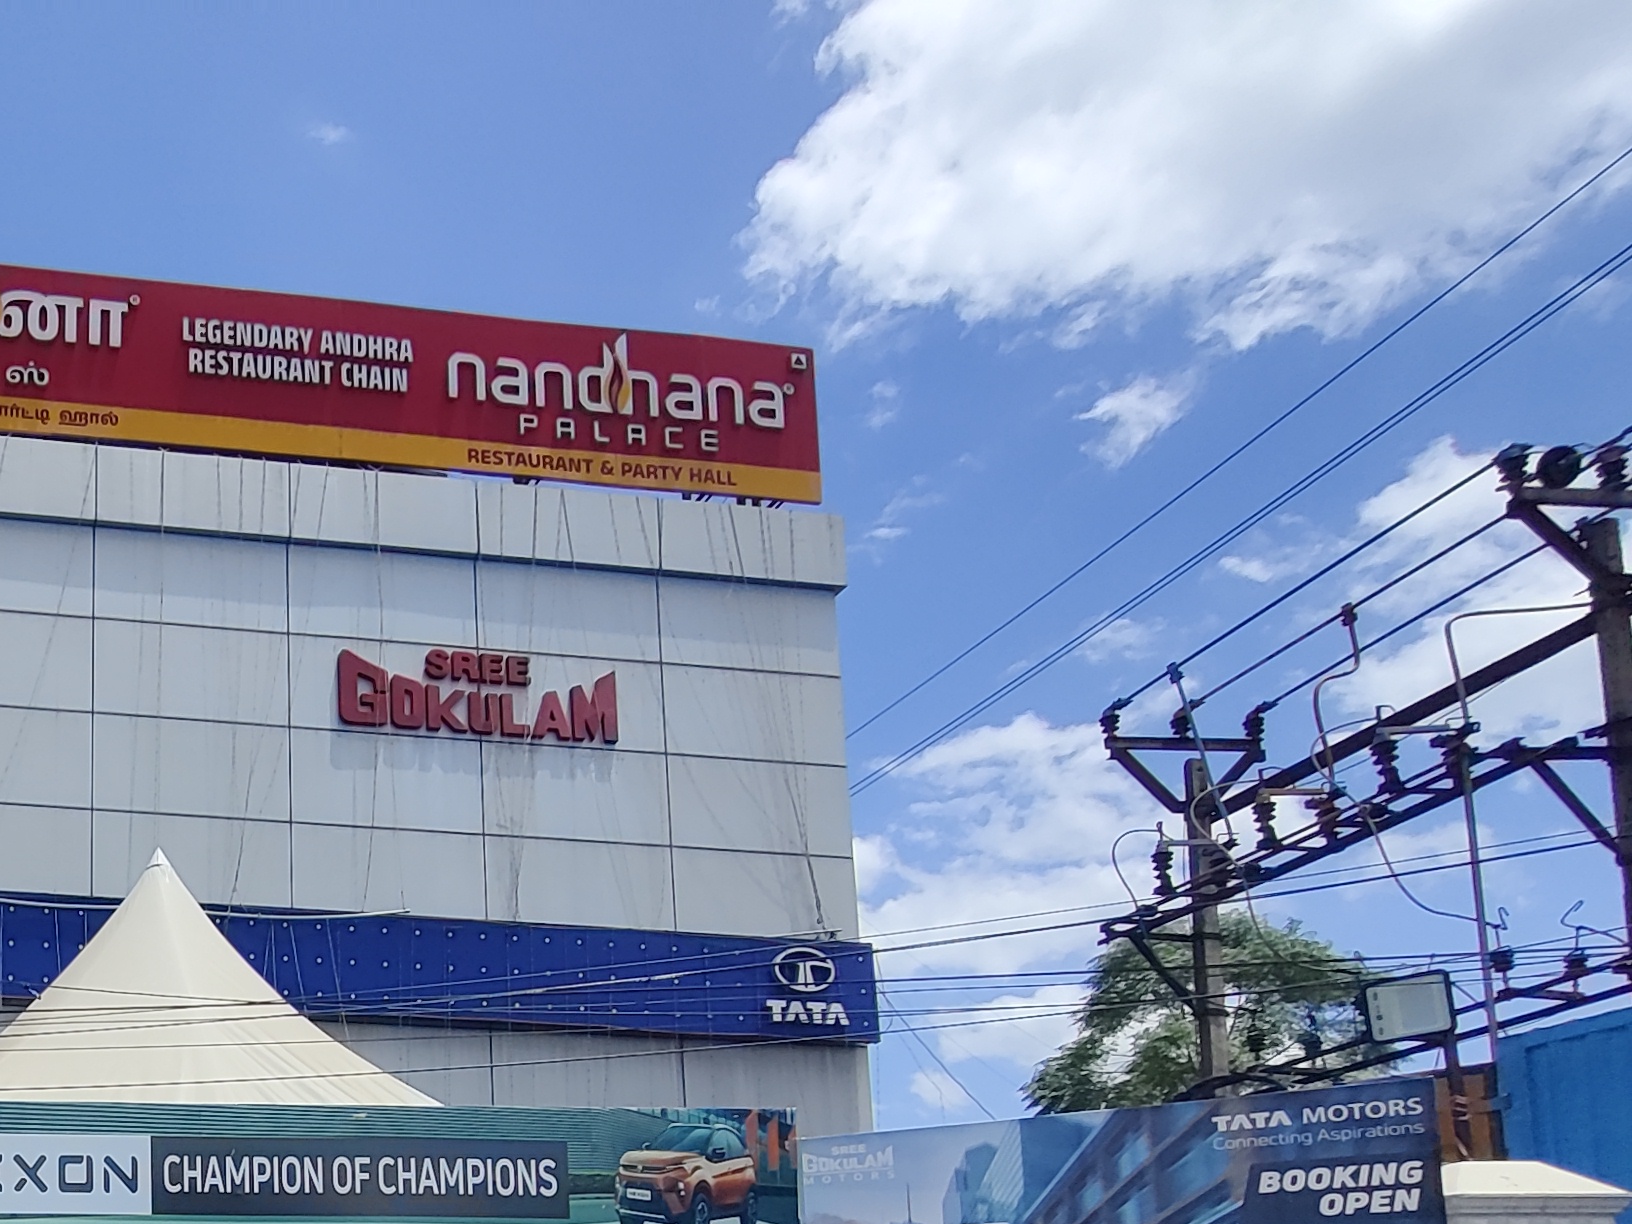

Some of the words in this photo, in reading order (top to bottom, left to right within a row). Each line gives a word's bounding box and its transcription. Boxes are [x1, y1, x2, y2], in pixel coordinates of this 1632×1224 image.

[182, 316, 314, 354] LEGENDARY
[320, 330, 414, 363] ANDHRA
[188, 347, 335, 385] RESTAURANT
[340, 361, 409, 393] CHAIN
[447, 332, 786, 429] nandhana
[58, 408, 120, 428] ஹால்
[519, 412, 720, 451] PALACE
[467, 447, 593, 475] RESTAURANT
[600, 460, 616, 477] &
[620, 462, 683, 482] PARTY
[689, 467, 738, 487] HALL
[423, 649, 532, 687] SREE
[337, 647, 619, 745] GOKULAM
[766, 998, 850, 1026] TATA
[1211, 1110, 1292, 1132] TATA
[1302, 1098, 1424, 1125] MOTORS
[831, 1144, 866, 1154] SREE
[1212, 1131, 1313, 1150] Connecting
[1317, 1122, 1425, 1142] Aspirations
[163, 1154, 324, 1196] CHAMPION
[331, 1155, 371, 1196] OF
[377, 1155, 559, 1198] CHAMPIONS
[802, 1145, 894, 1173] GOKULAM
[803, 1170, 895, 1185] MOTORS
[1258, 1160, 1424, 1194] BOOKING
[1318, 1188, 1421, 1217] OPEN
